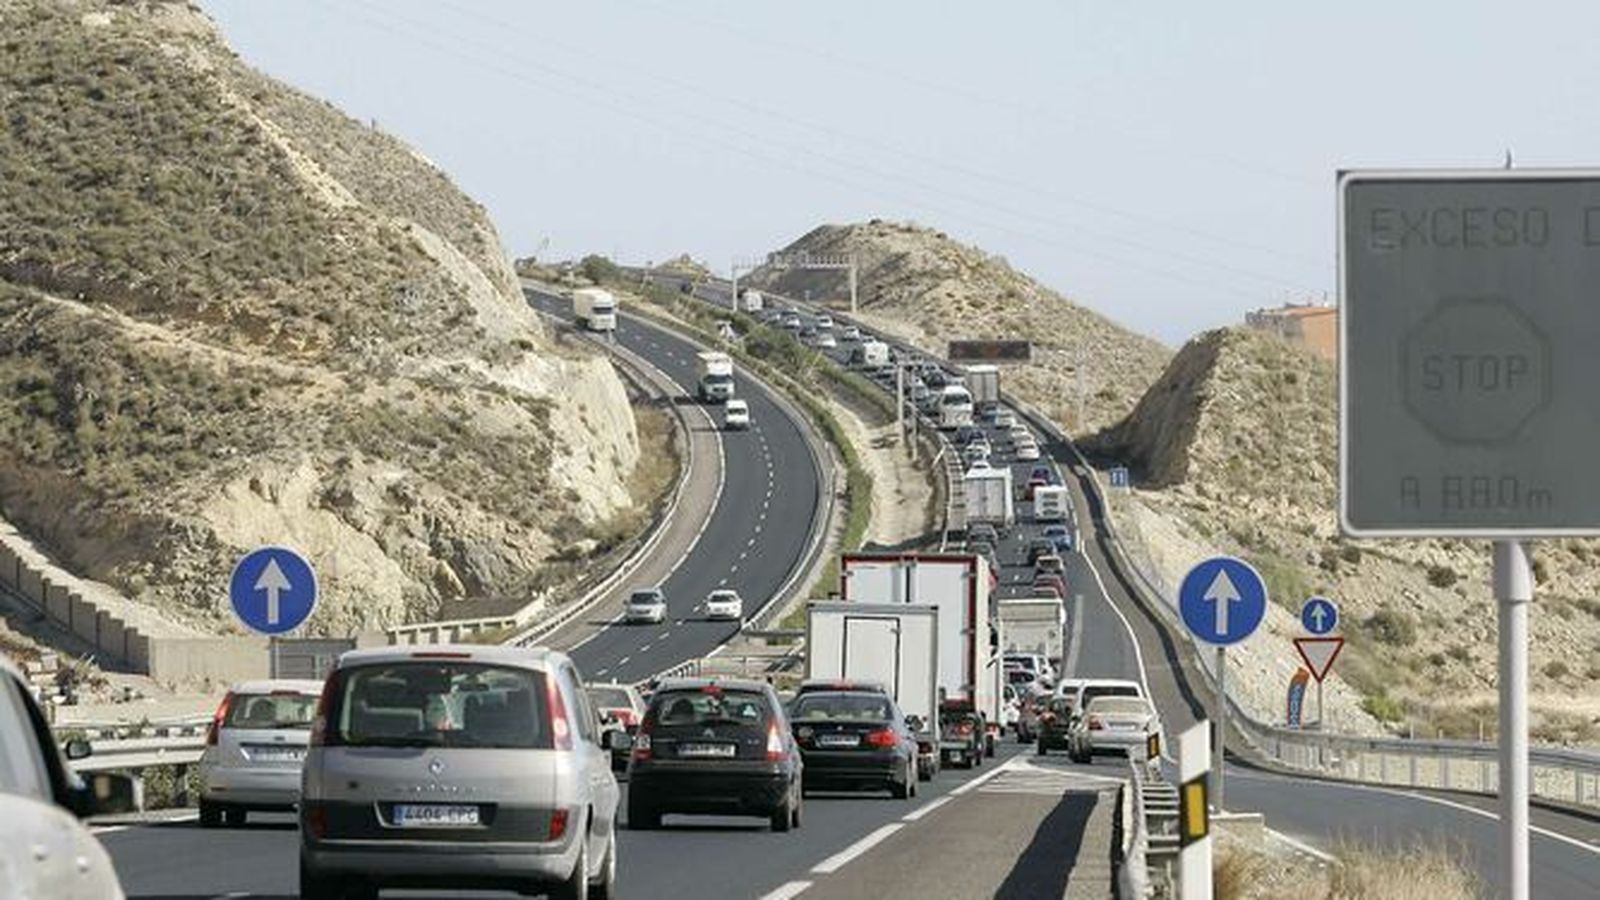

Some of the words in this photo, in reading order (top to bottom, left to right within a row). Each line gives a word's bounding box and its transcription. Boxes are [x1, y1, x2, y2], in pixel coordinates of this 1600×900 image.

[1370, 206, 1550, 250] EXCESO
[1422, 353, 1529, 392] STOP
[1399, 475, 1421, 510] A
